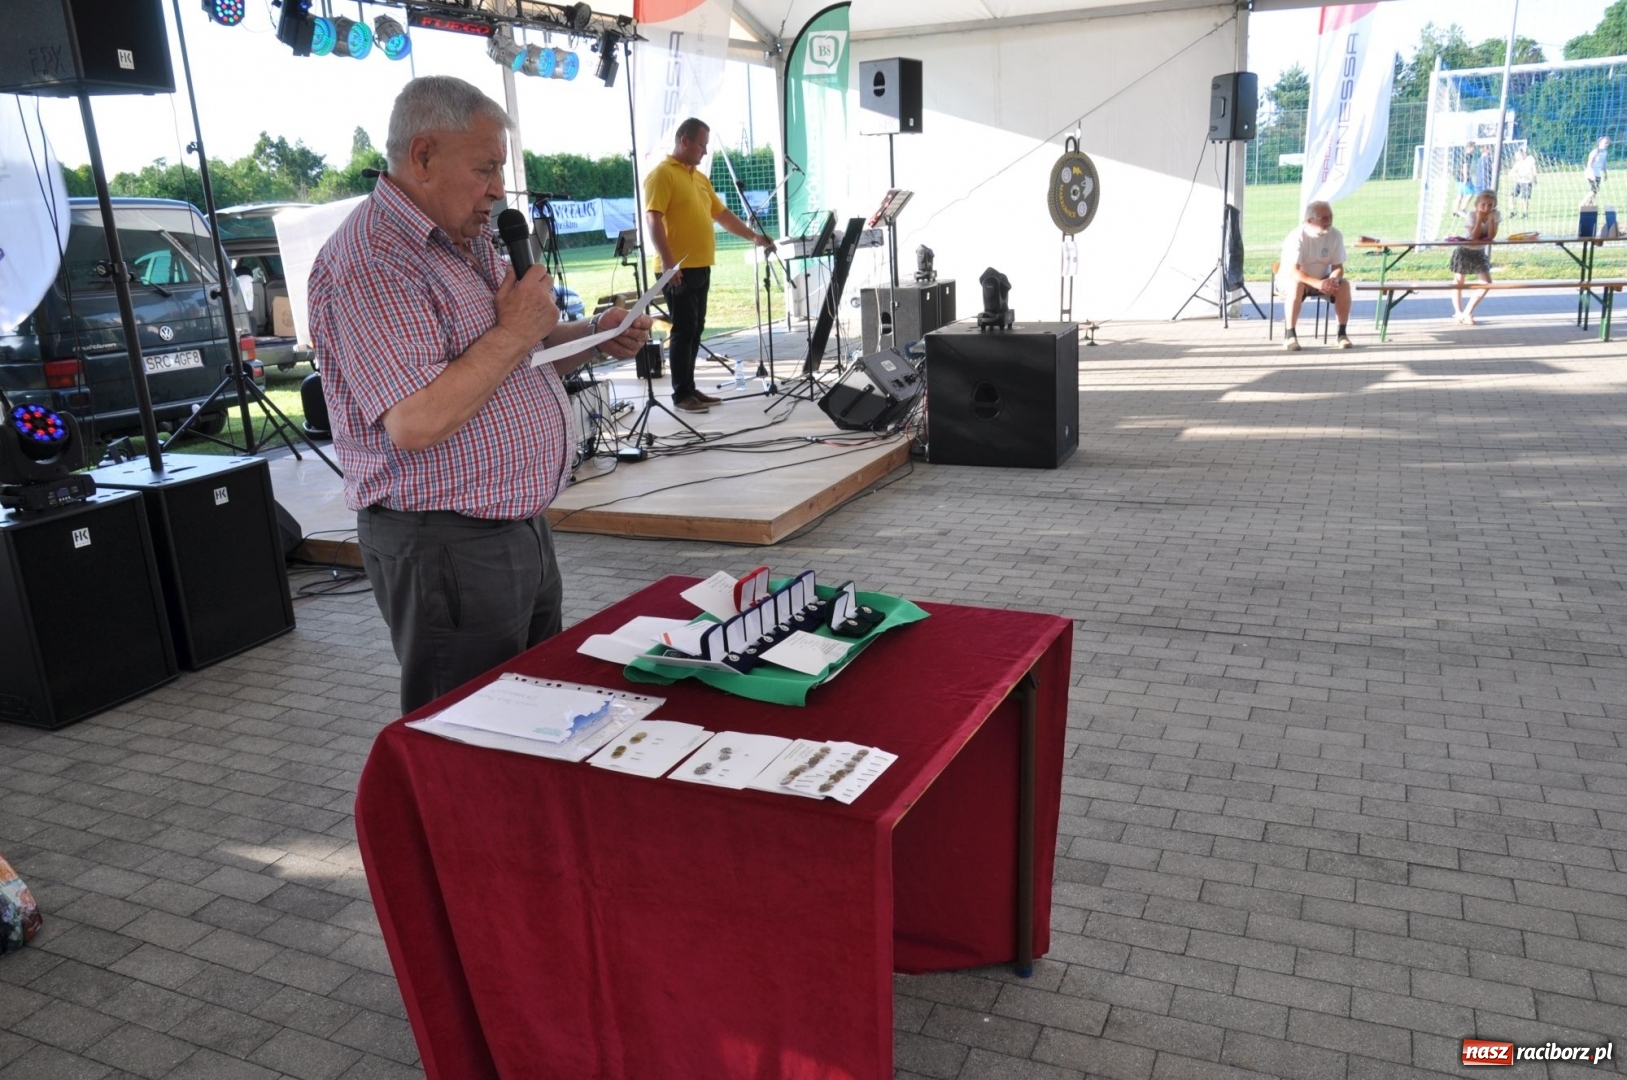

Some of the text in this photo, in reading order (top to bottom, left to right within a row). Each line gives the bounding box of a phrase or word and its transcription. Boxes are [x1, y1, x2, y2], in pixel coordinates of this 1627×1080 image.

[1334, 32, 1360, 182] VANESSA
[146, 350, 201, 371] SRC 4GF8
[215, 488, 227, 500] HK
[74, 529, 89, 543] HK
